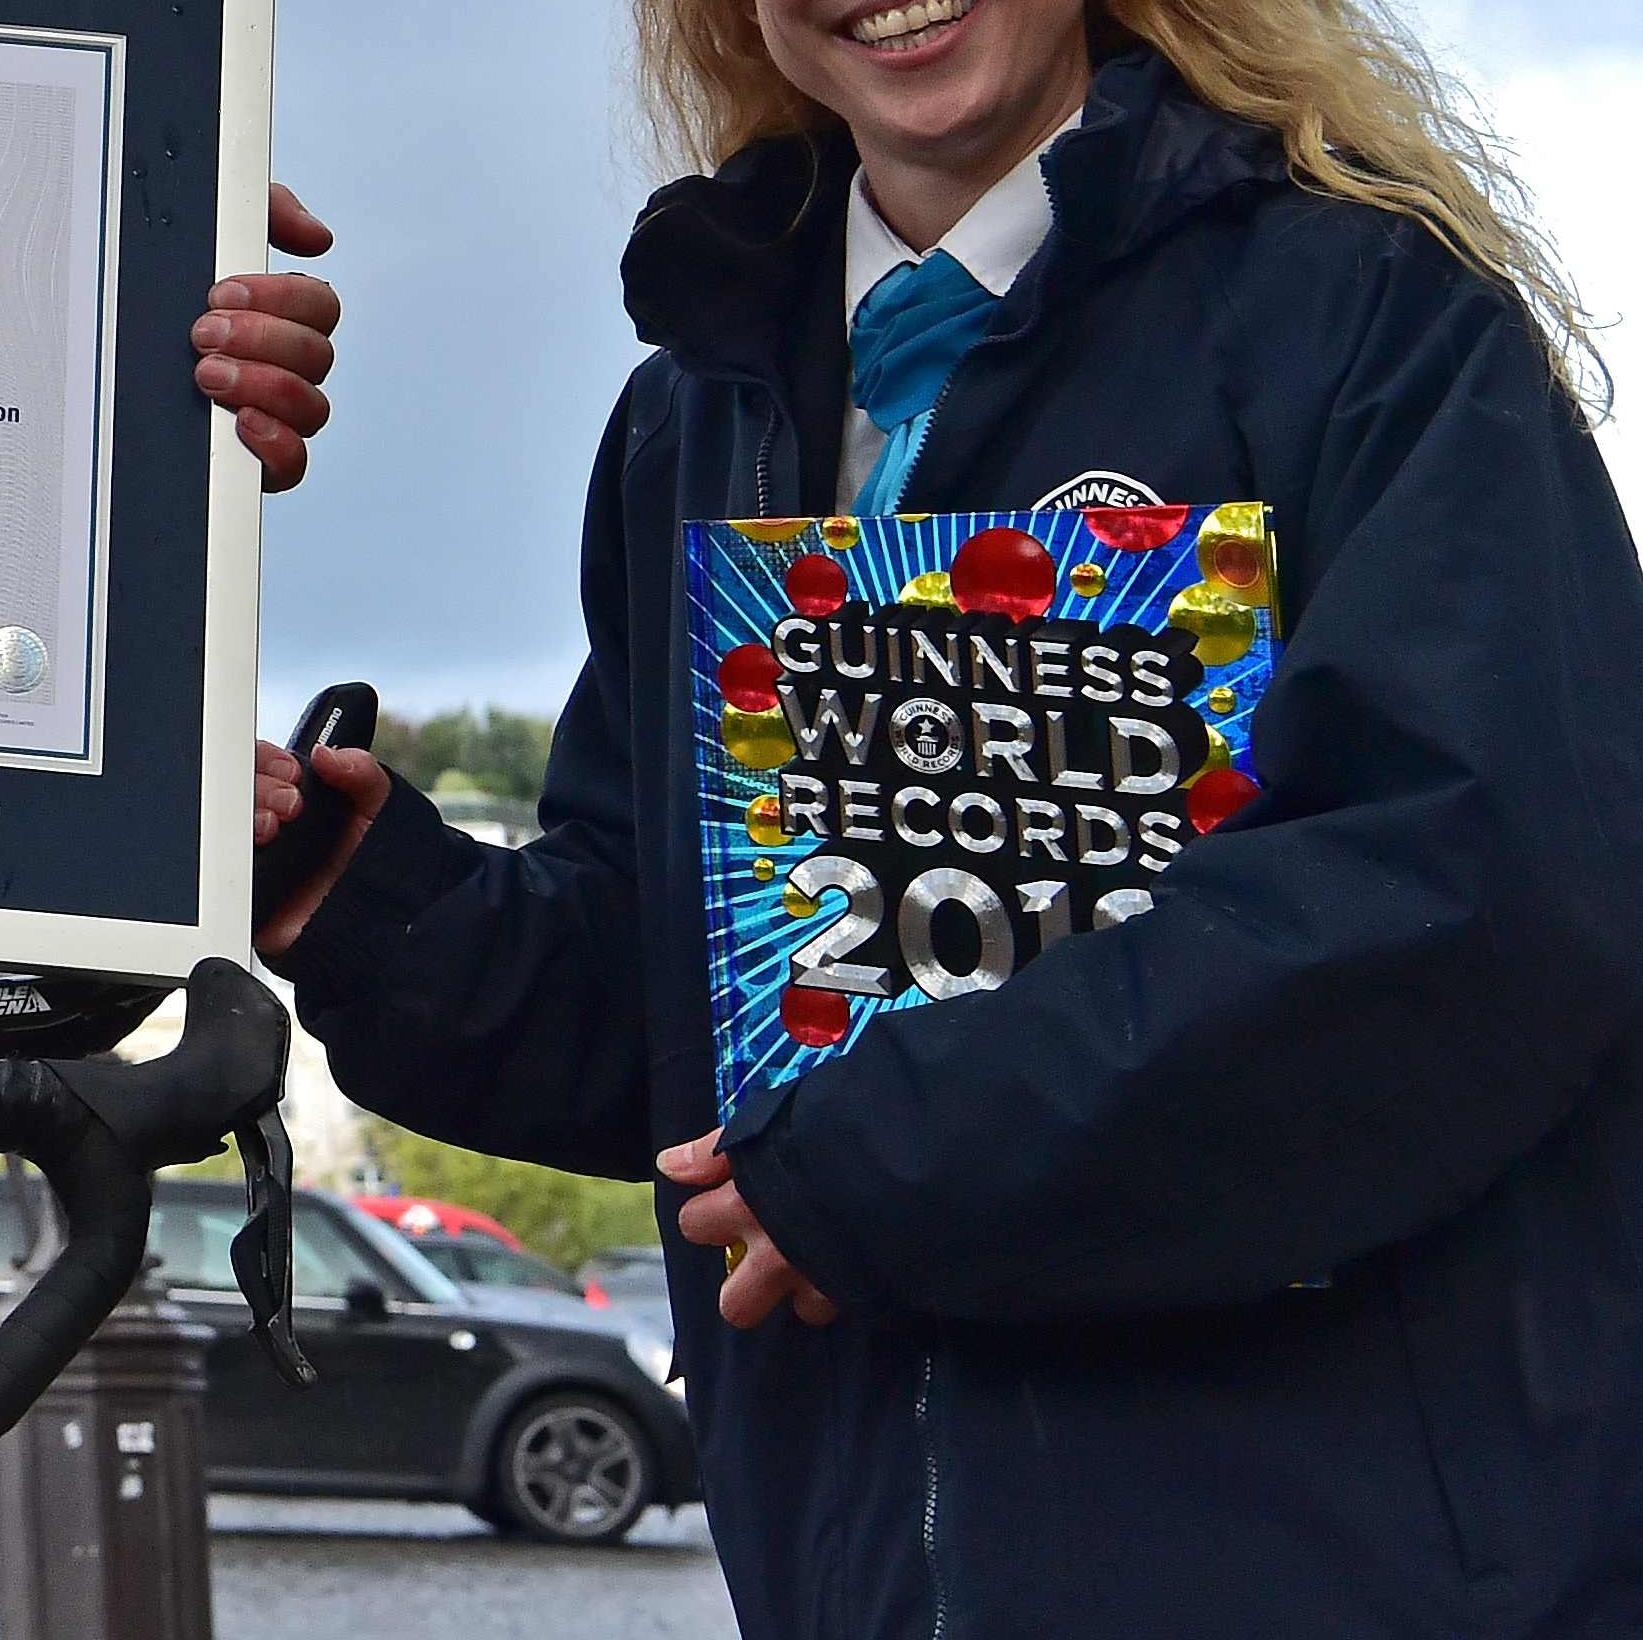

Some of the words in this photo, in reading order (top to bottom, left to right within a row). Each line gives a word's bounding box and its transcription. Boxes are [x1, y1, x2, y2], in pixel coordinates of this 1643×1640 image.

[772, 618, 1175, 706] GUINNESS
[780, 773, 1183, 872] RECORDS
[787, 855, 1153, 1000] 201
